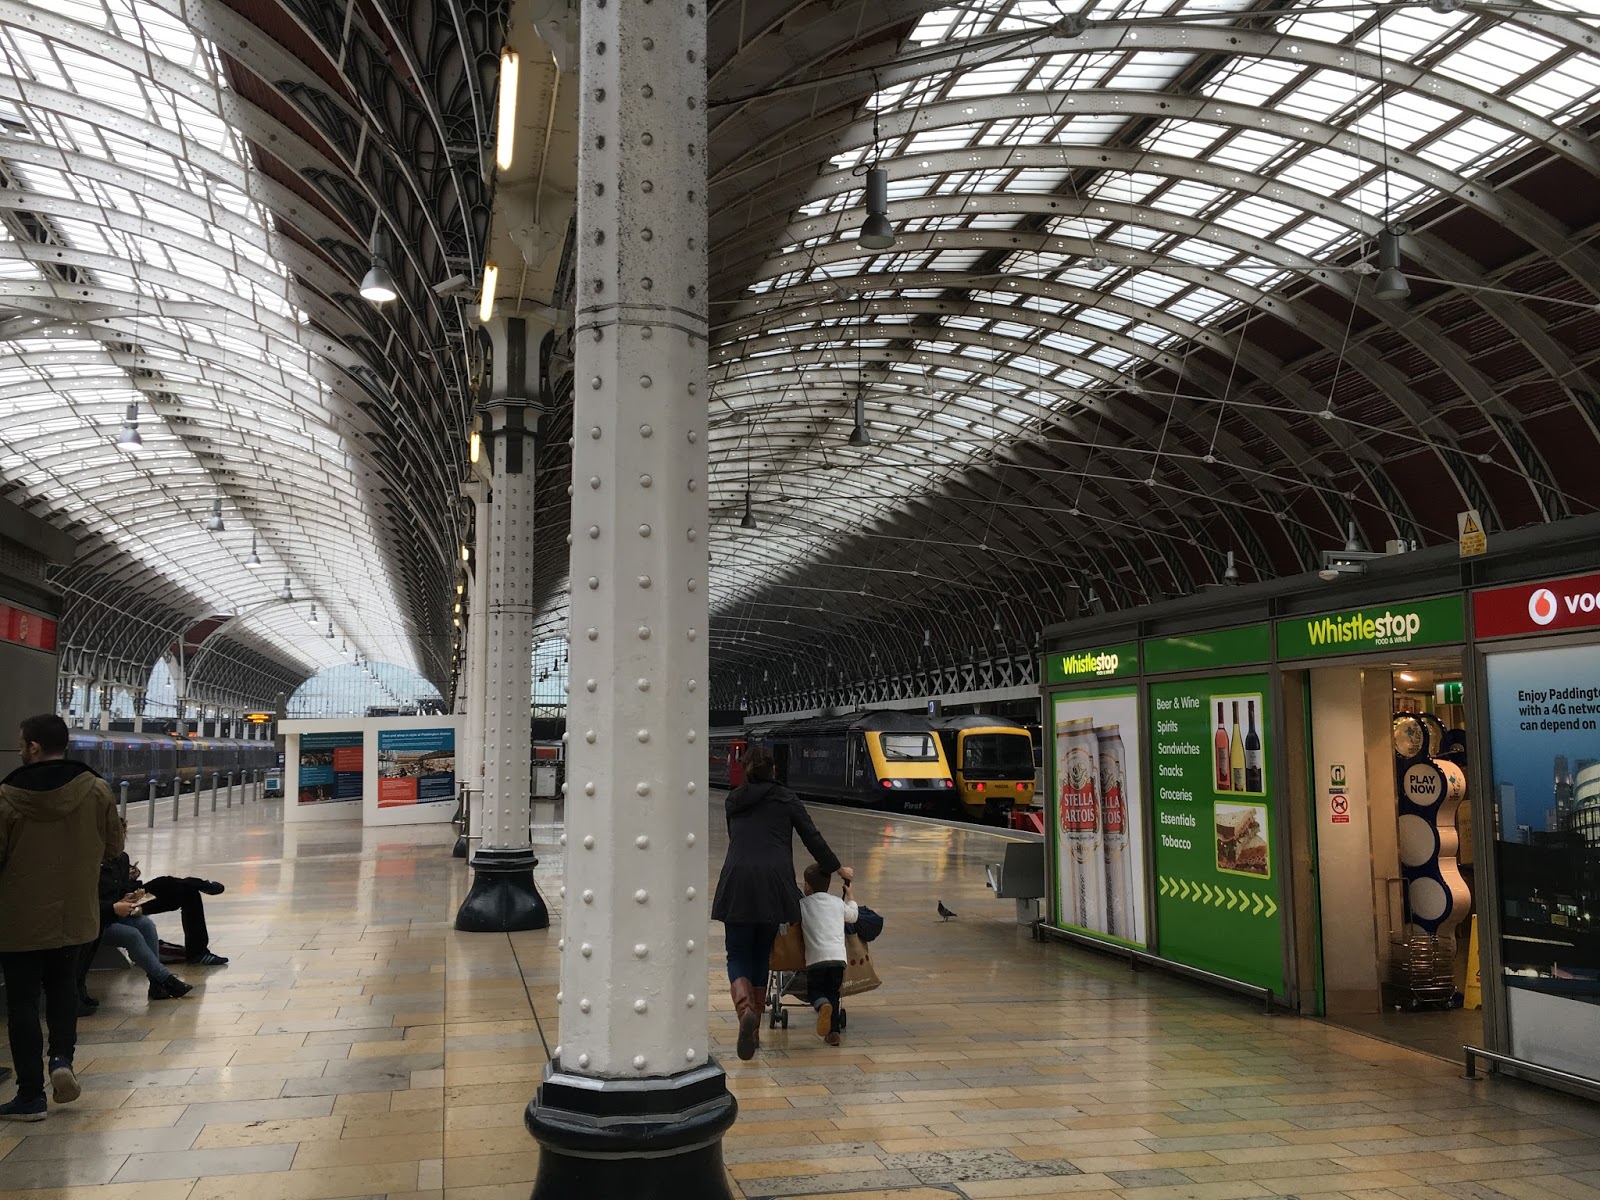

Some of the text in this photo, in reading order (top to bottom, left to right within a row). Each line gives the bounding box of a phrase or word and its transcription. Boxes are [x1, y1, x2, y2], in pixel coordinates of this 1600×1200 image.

[1564, 591, 1600, 614] vo
[1308, 611, 1420, 645] Whistlestop
[1063, 652, 1119, 675] Whistlestop
[1156, 696, 1200, 710] Beer & Wine
[1518, 690, 1547, 703] Enjoy
[1519, 704, 1542, 716] with
[1543, 706, 1550, 715] a
[1552, 703, 1566, 715] 4G
[1157, 720, 1178, 735] Spirits
[1520, 718, 1597, 733] can depend on
[1158, 742, 1200, 755] Sandwiches
[1158, 764, 1184, 777] Snacks
[1409, 774, 1436, 784] PLAY
[1159, 787, 1193, 802] Groceries
[1410, 784, 1436, 795] NOW
[903, 801, 923, 809] First
[1064, 792, 1094, 807] STELLA
[1101, 795, 1120, 809] ELLA
[1065, 808, 1095, 823] ARTOIS
[1102, 810, 1121, 824] TOIS
[1160, 812, 1196, 828] Essentials
[1161, 834, 1192, 850] Tobacco
